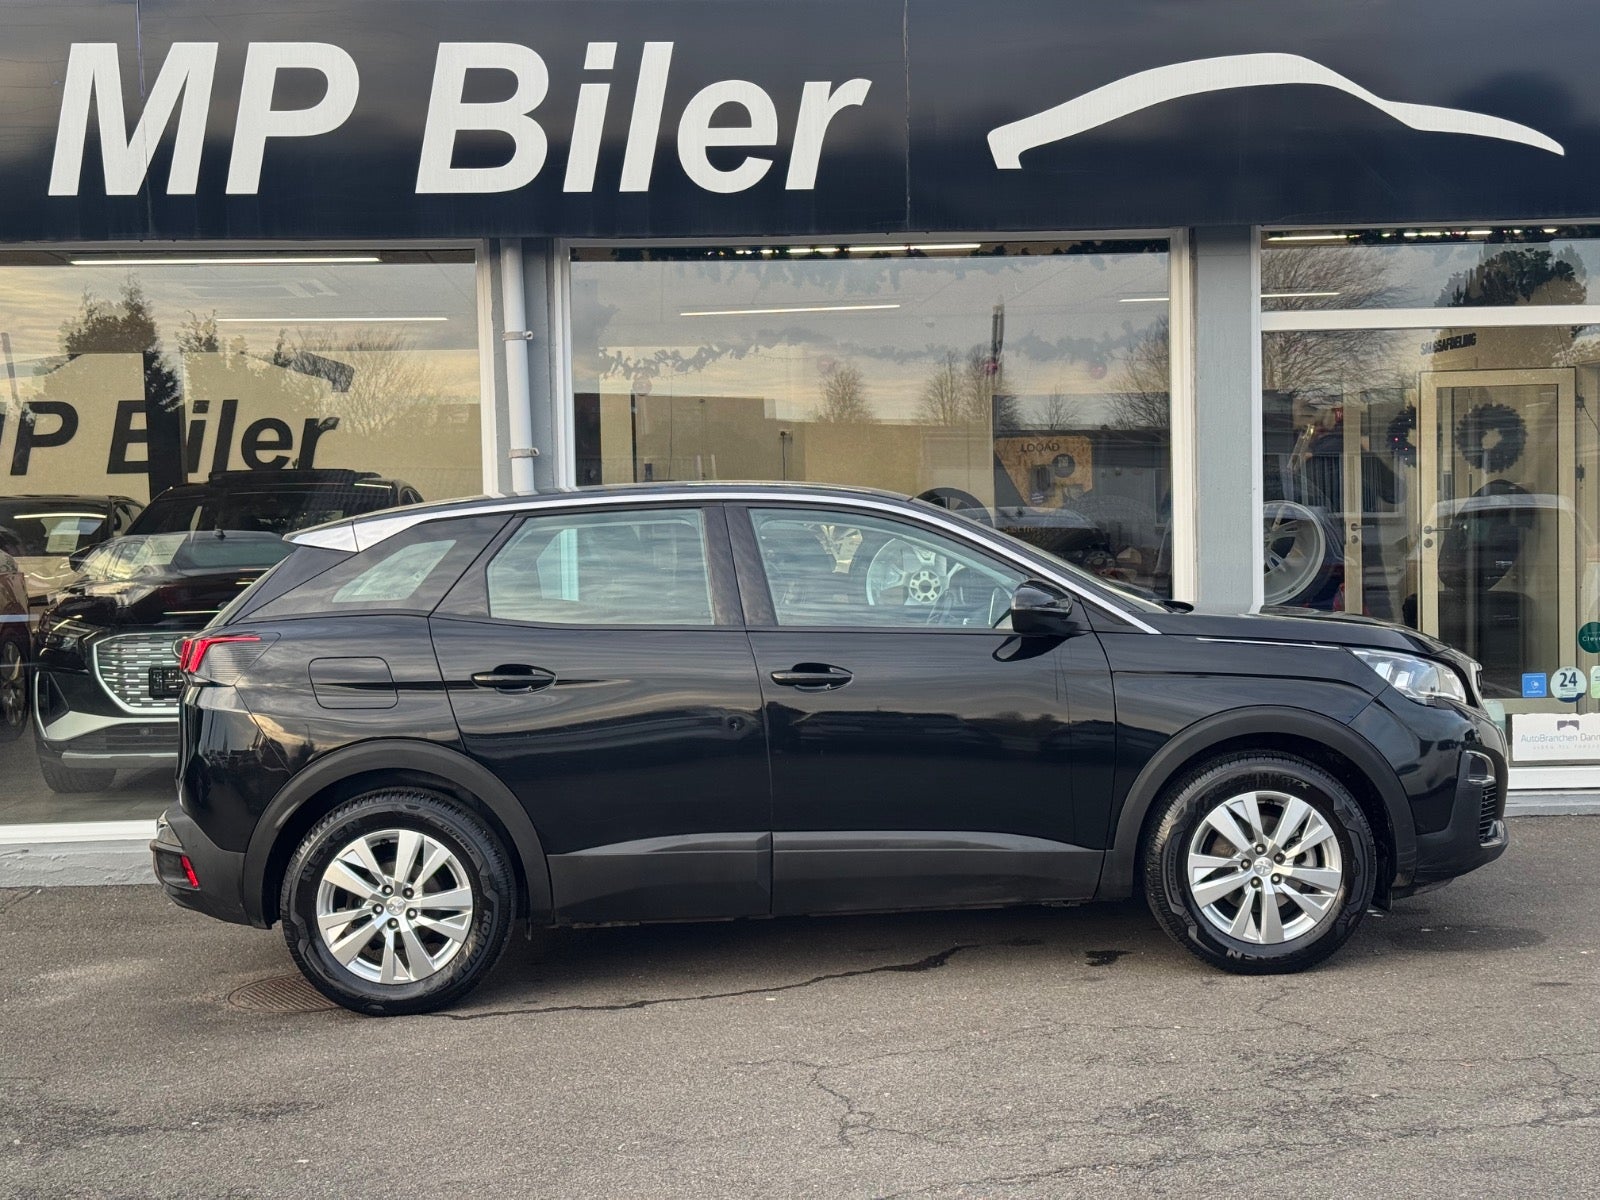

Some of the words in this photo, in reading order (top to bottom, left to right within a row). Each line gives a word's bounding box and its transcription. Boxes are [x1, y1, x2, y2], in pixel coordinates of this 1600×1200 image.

[48, 41, 360, 196] MP
[414, 41, 872, 194] Biler
[0, 400, 79, 476] P
[1559, 671, 1578, 688] 24
[1520, 733, 1578, 743] AutoBranchen
